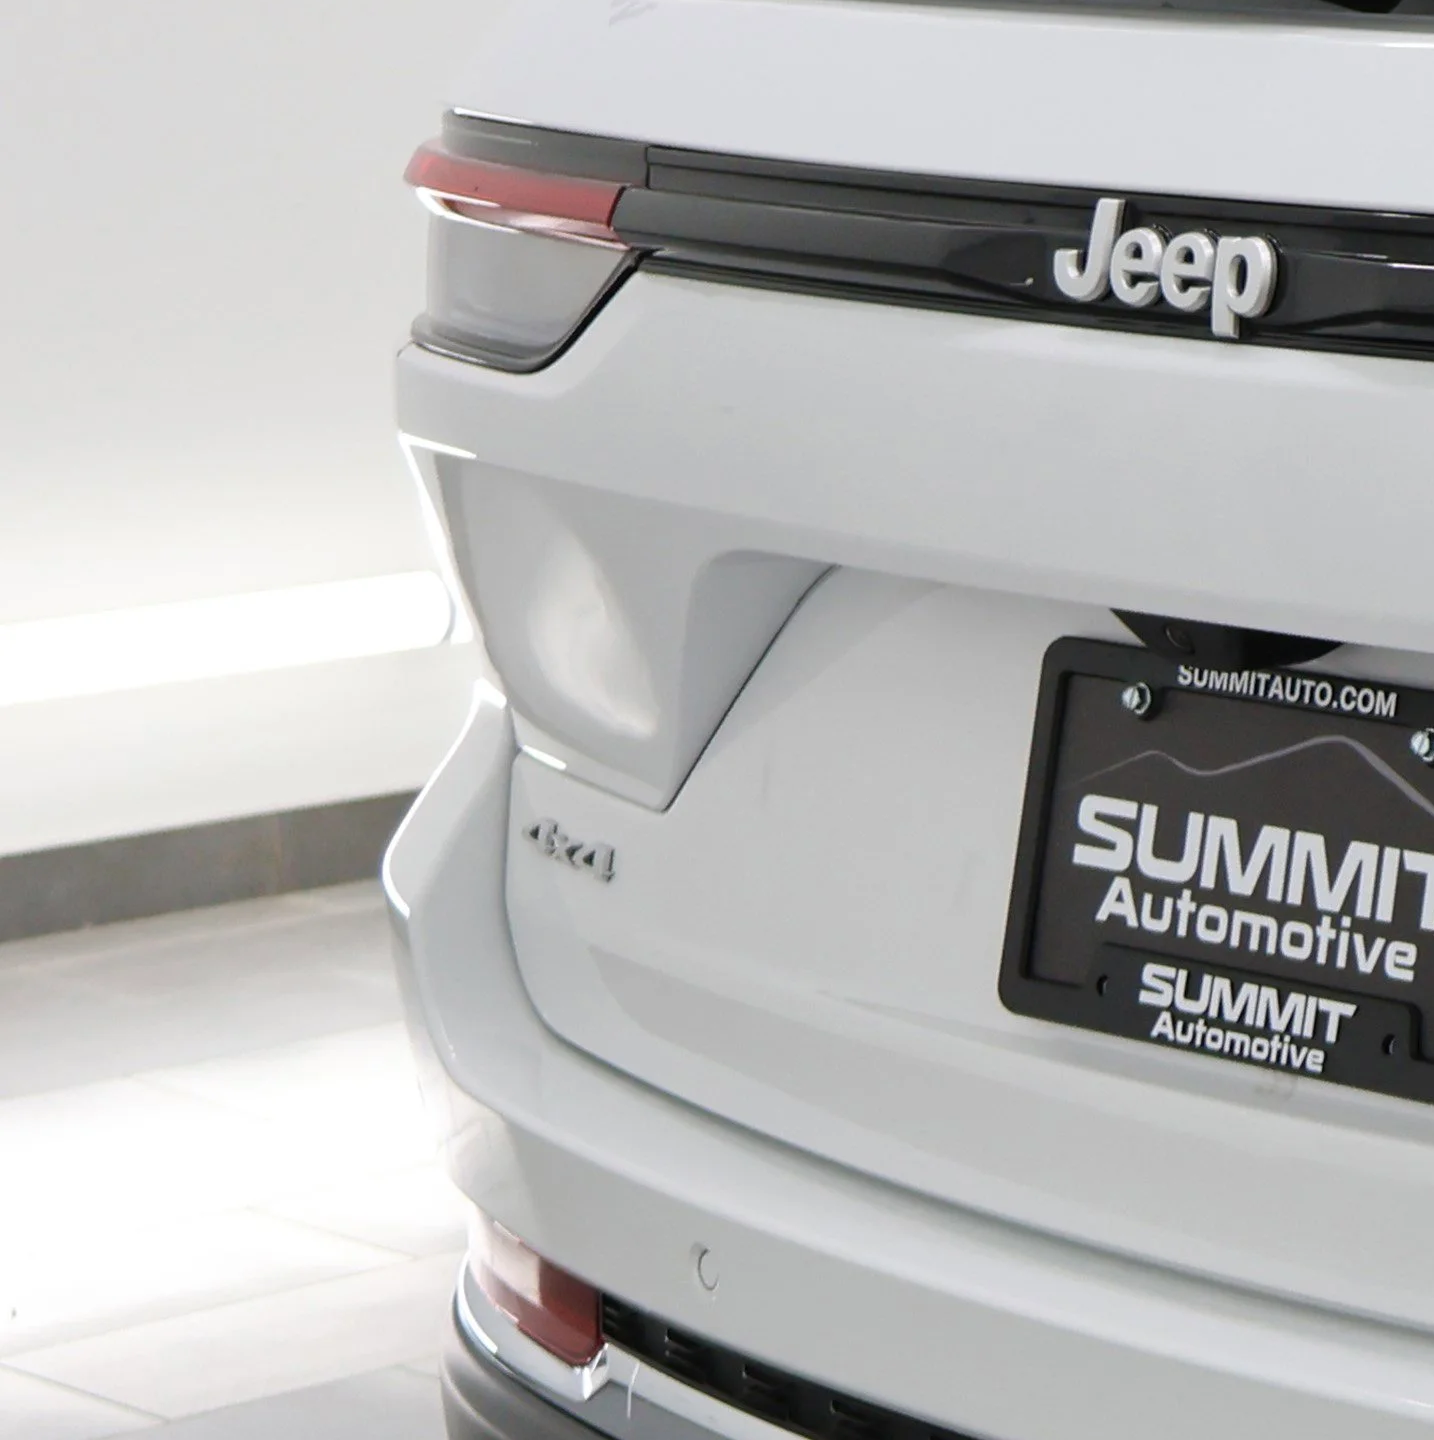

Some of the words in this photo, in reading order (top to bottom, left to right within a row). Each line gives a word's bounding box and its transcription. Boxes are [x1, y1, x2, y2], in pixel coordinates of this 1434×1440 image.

[1053, 197, 1278, 339] Jeep
[1177, 664, 1398, 718] SUMMITAUTO.COM
[1095, 876, 1418, 983] Automotive
[1138, 962, 1357, 1044] SUMMIT
[1151, 1011, 1326, 1074] Automotive
